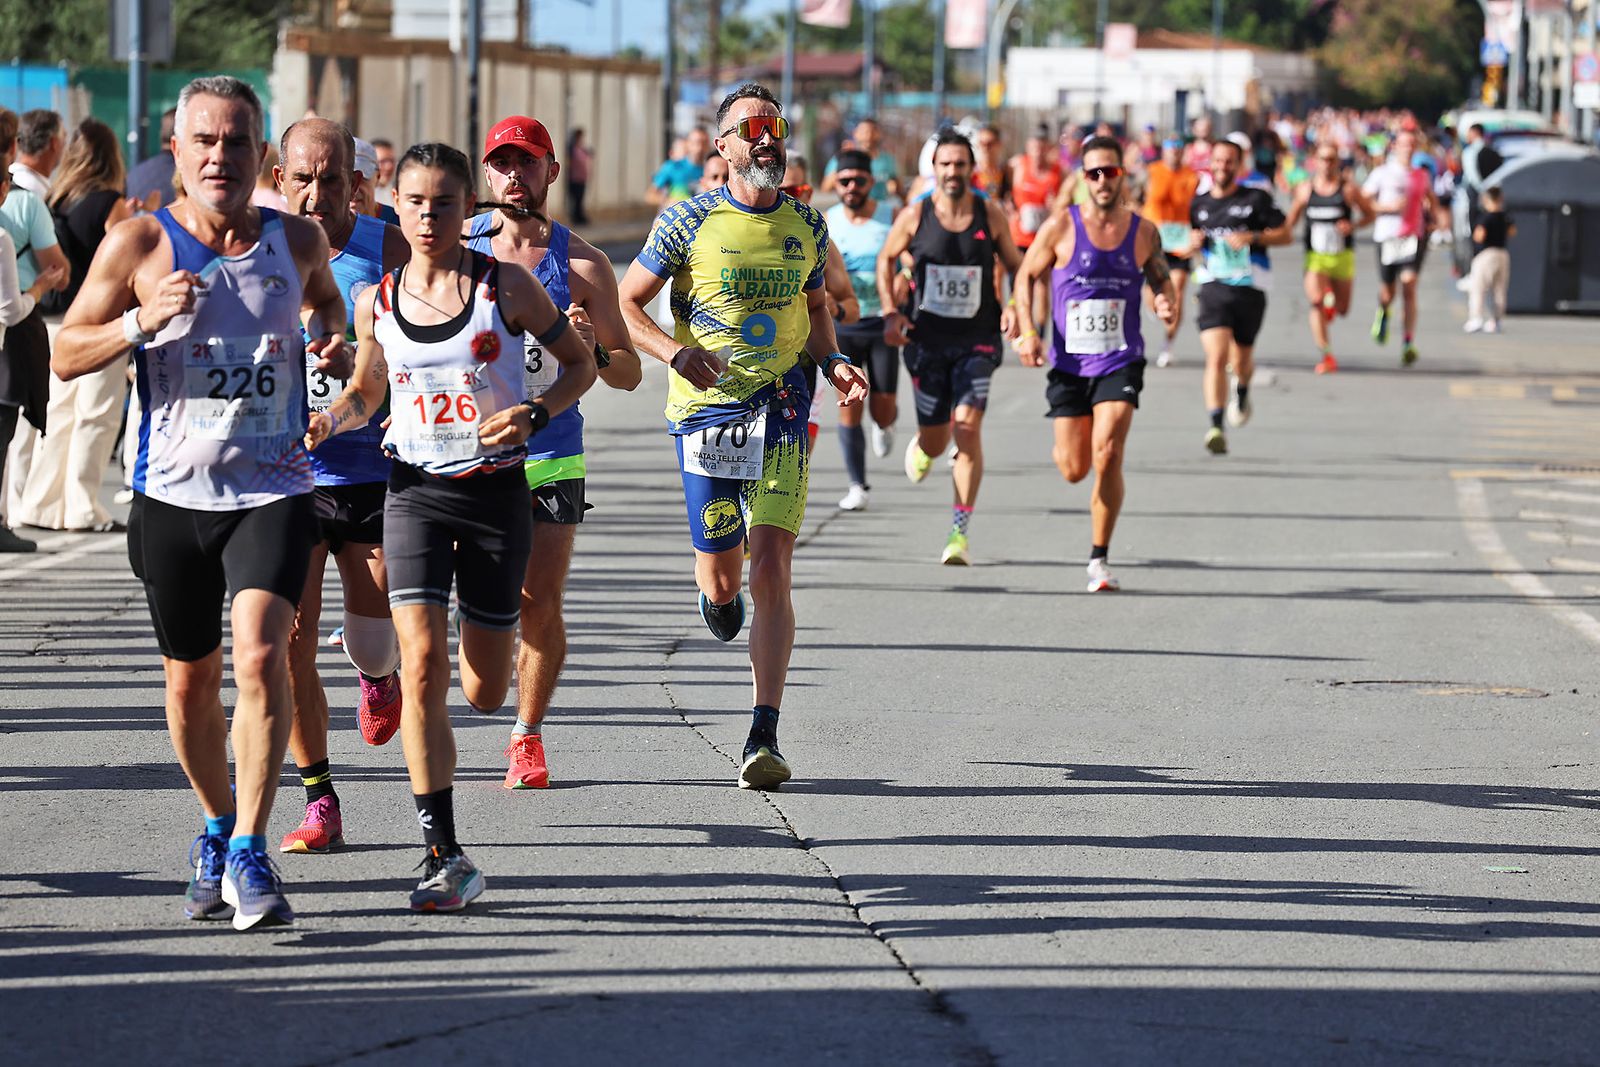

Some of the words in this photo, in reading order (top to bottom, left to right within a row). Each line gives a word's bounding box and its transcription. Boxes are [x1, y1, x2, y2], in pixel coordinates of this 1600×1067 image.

[720, 267, 784, 281] CANILLAS
[787, 269, 801, 283] DE
[721, 281, 800, 300] ALBAIDA
[936, 280, 970, 299] 183
[1074, 312, 1119, 333] 1339
[207, 365, 275, 400] 226
[413, 393, 477, 425] 126
[717, 454, 748, 463] TELLEZ
